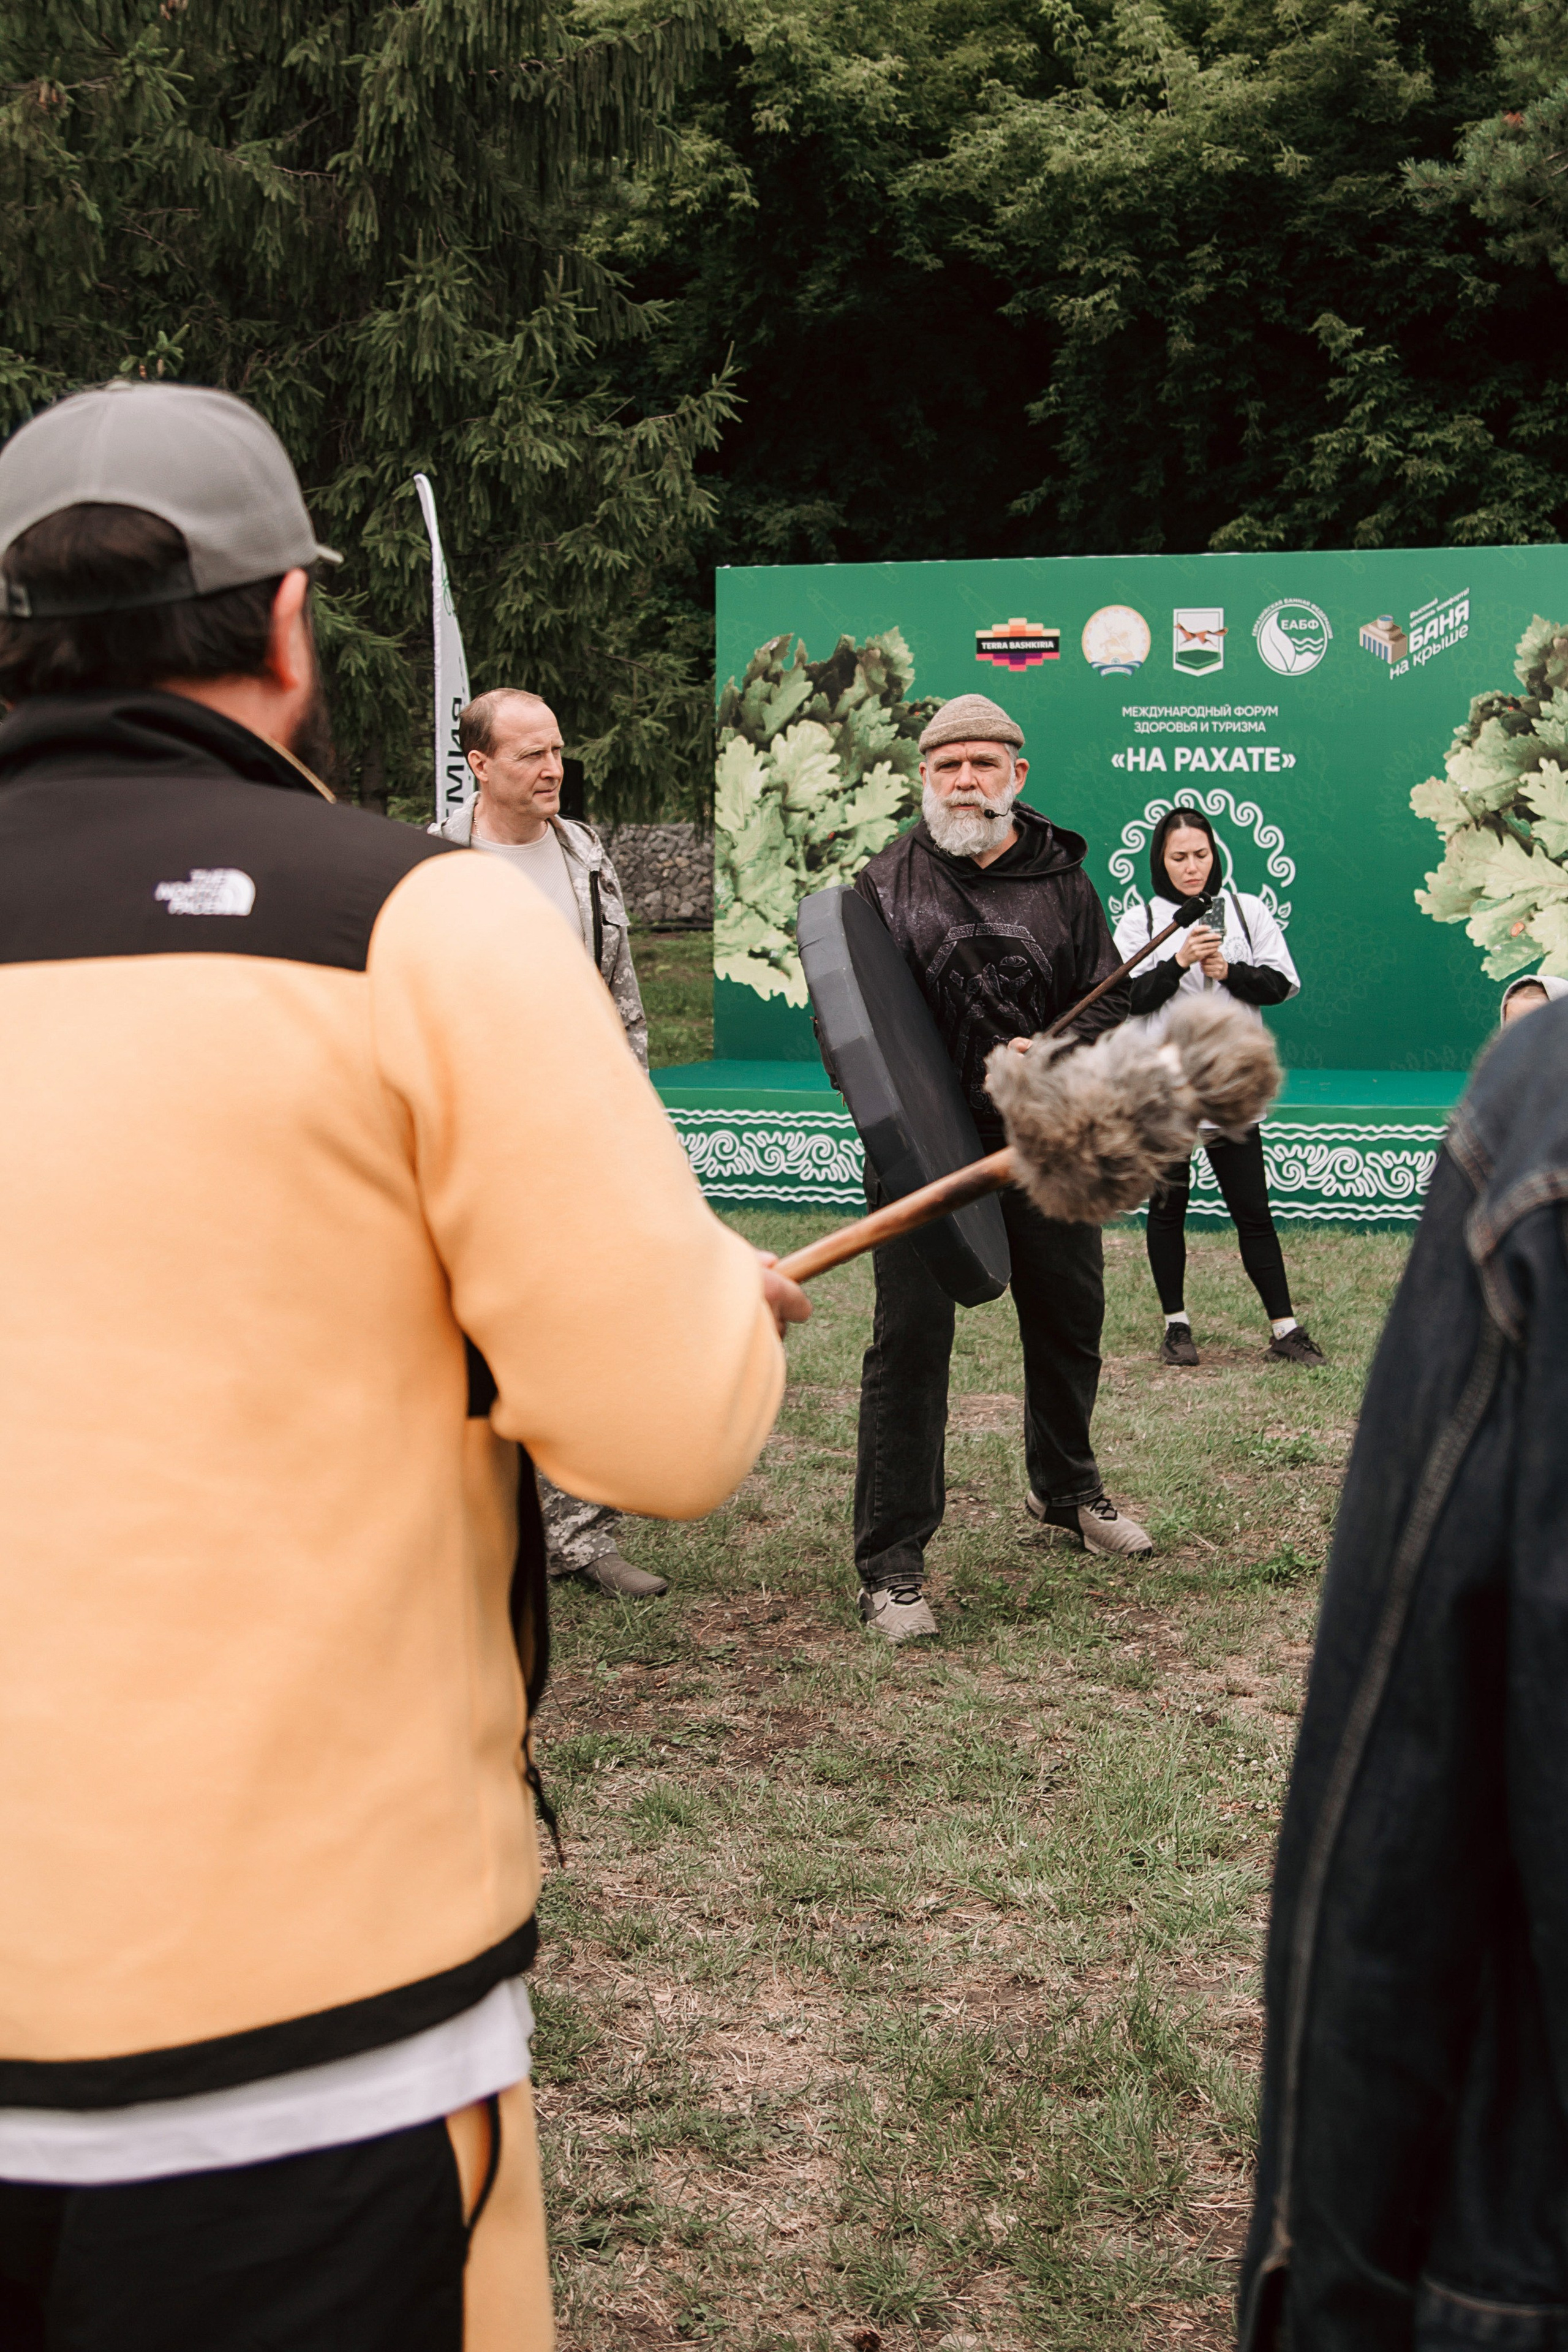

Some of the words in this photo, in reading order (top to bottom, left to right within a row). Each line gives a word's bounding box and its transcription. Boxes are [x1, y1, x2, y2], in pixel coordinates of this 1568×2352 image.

[1281, 619, 1319, 630] ЕАБФ
[1409, 599, 1469, 654] БАНЯ
[1009, 641, 1054, 649] BASHKIRIA
[1389, 659, 1409, 680] на
[1413, 624, 1469, 666] крыше
[1122, 704, 1231, 718] МЕЖДУНАРОДНЫЙ
[1234, 706, 1278, 717] ФОРУМ
[1134, 722, 1197, 734] ЗДОРОВЬЯ
[1200, 722, 1209, 733] И
[1212, 722, 1266, 733] ТУРИЗМА
[1111, 747, 1167, 772] «НА
[1174, 747, 1296, 772] РАХАТЕ»
